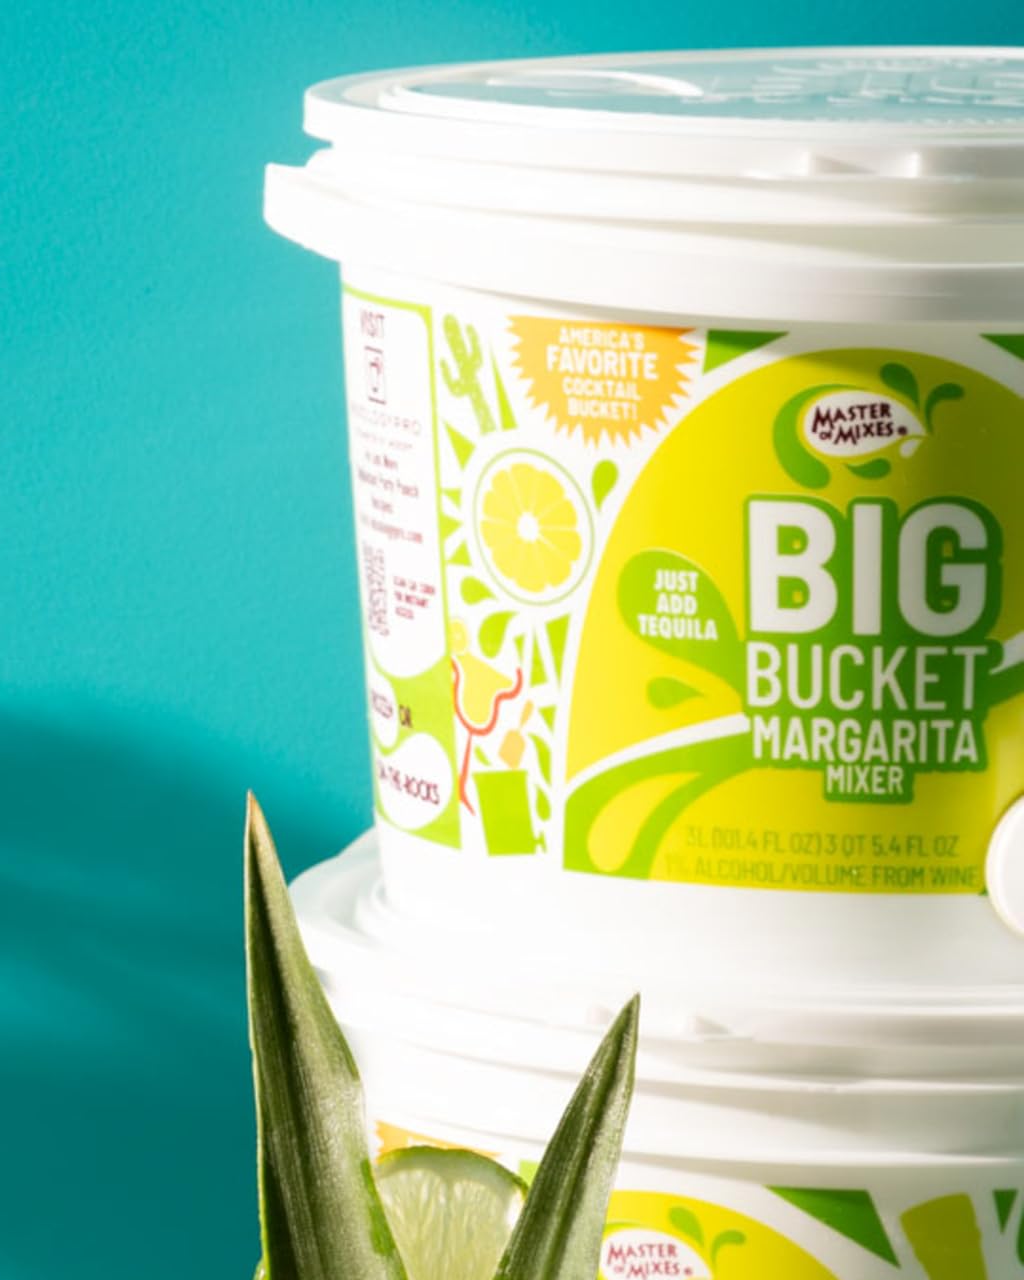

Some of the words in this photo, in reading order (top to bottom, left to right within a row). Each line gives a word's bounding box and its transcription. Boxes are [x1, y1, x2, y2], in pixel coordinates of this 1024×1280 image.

[559, 327, 645, 350] AMERICA'S
[546, 345, 659, 380] FAVORITE
[562, 377, 642, 401] COCKTAIL
[567, 397, 637, 420] BUCKET!
[811, 402, 891, 433] MASTER
[834, 422, 894, 445] MIXES
[654, 569, 698, 592] JUST
[749, 500, 987, 637] BIG
[656, 592, 698, 616] ADD
[637, 613, 719, 641] TEQUILA
[747, 641, 988, 710] BUCKET
[752, 715, 979, 764] MARGARITA
[826, 765, 904, 795] MIXER
[686, 825, 706, 848] 3L
[762, 829, 785, 853] FL
[842, 833, 865, 858] QT
[872, 834, 901, 857] 5.4
[906, 835, 928, 857] FL
[934, 835, 960, 858] OZ
[695, 856, 866, 887] ALCOHOL/VOLUME
[871, 864, 925, 888] FROM
[927, 865, 976, 888] WINE
[607, 1242, 677, 1265] MASTER
[626, 1261, 680, 1280] MIXES
